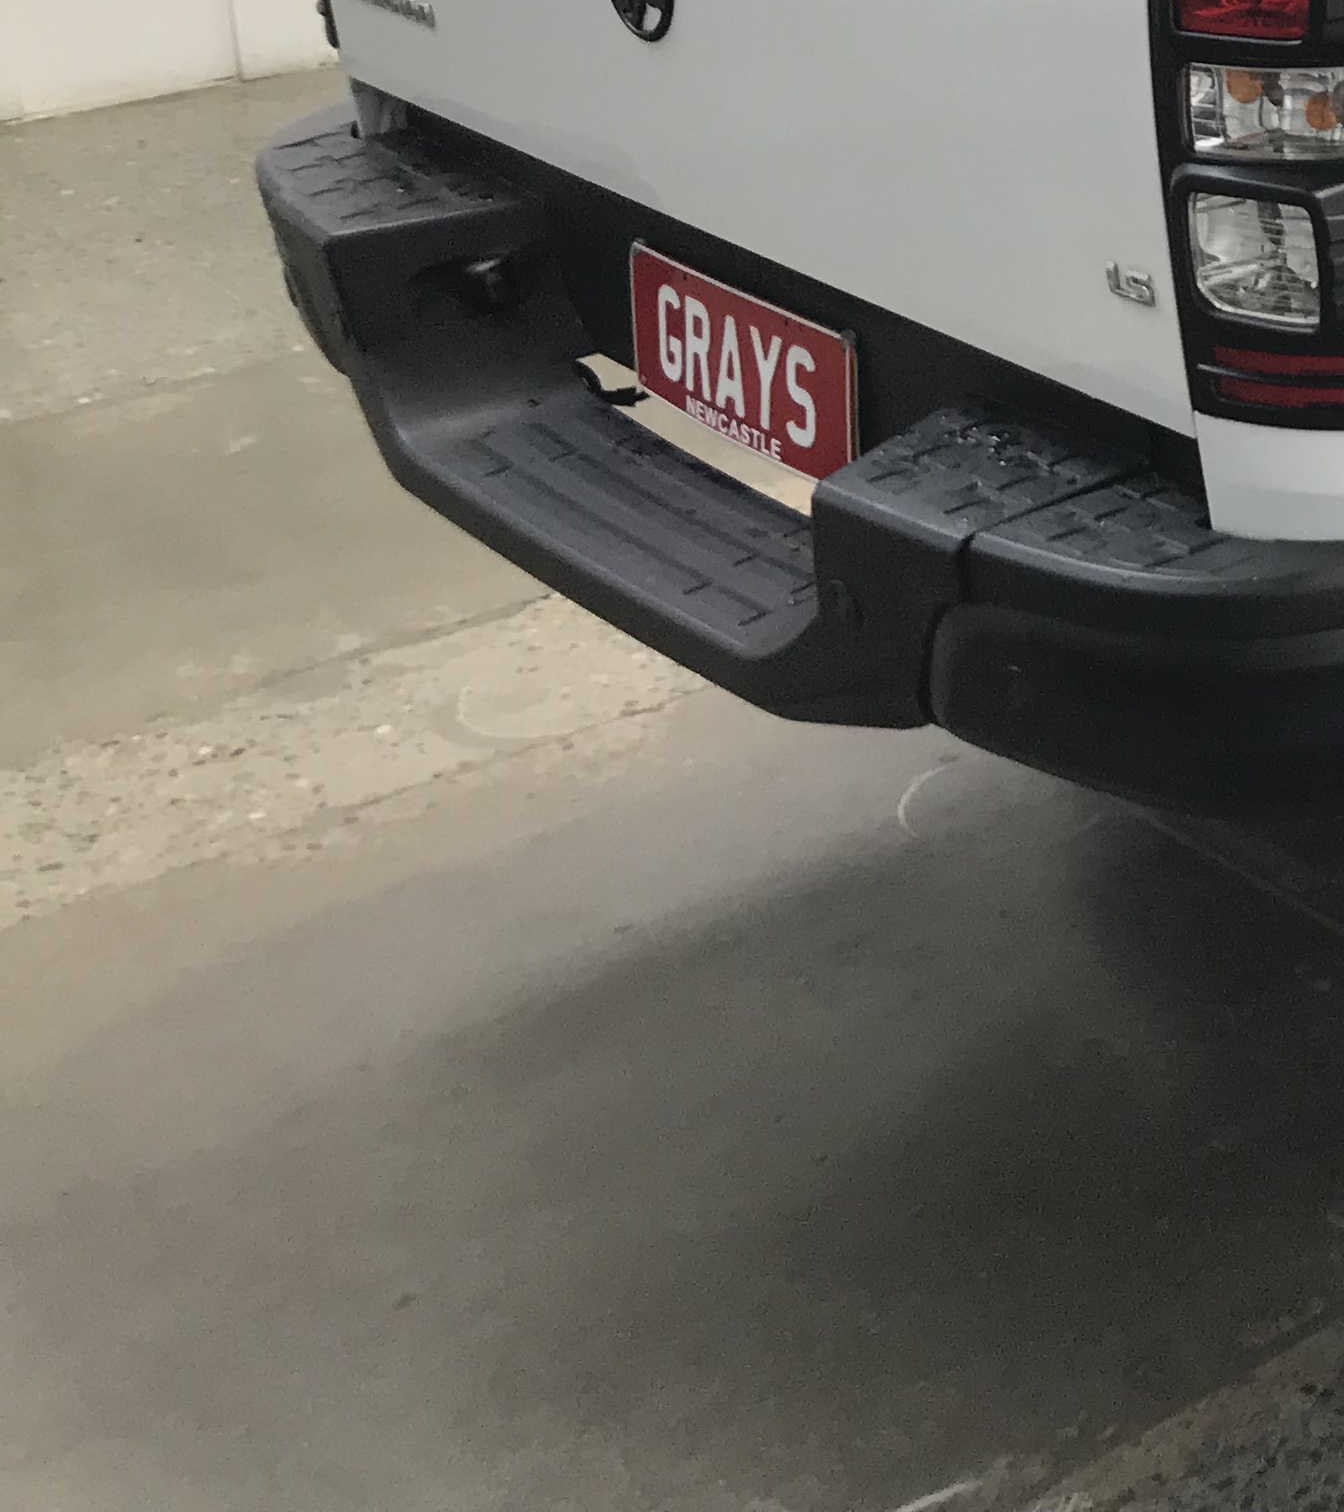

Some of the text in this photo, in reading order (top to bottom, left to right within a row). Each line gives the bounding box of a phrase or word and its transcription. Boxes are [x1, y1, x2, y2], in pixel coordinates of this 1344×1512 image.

[1106, 261, 1156, 307] LS
[658, 284, 817, 448] GRAYS
[686, 395, 782, 461] NEWCASTLE
